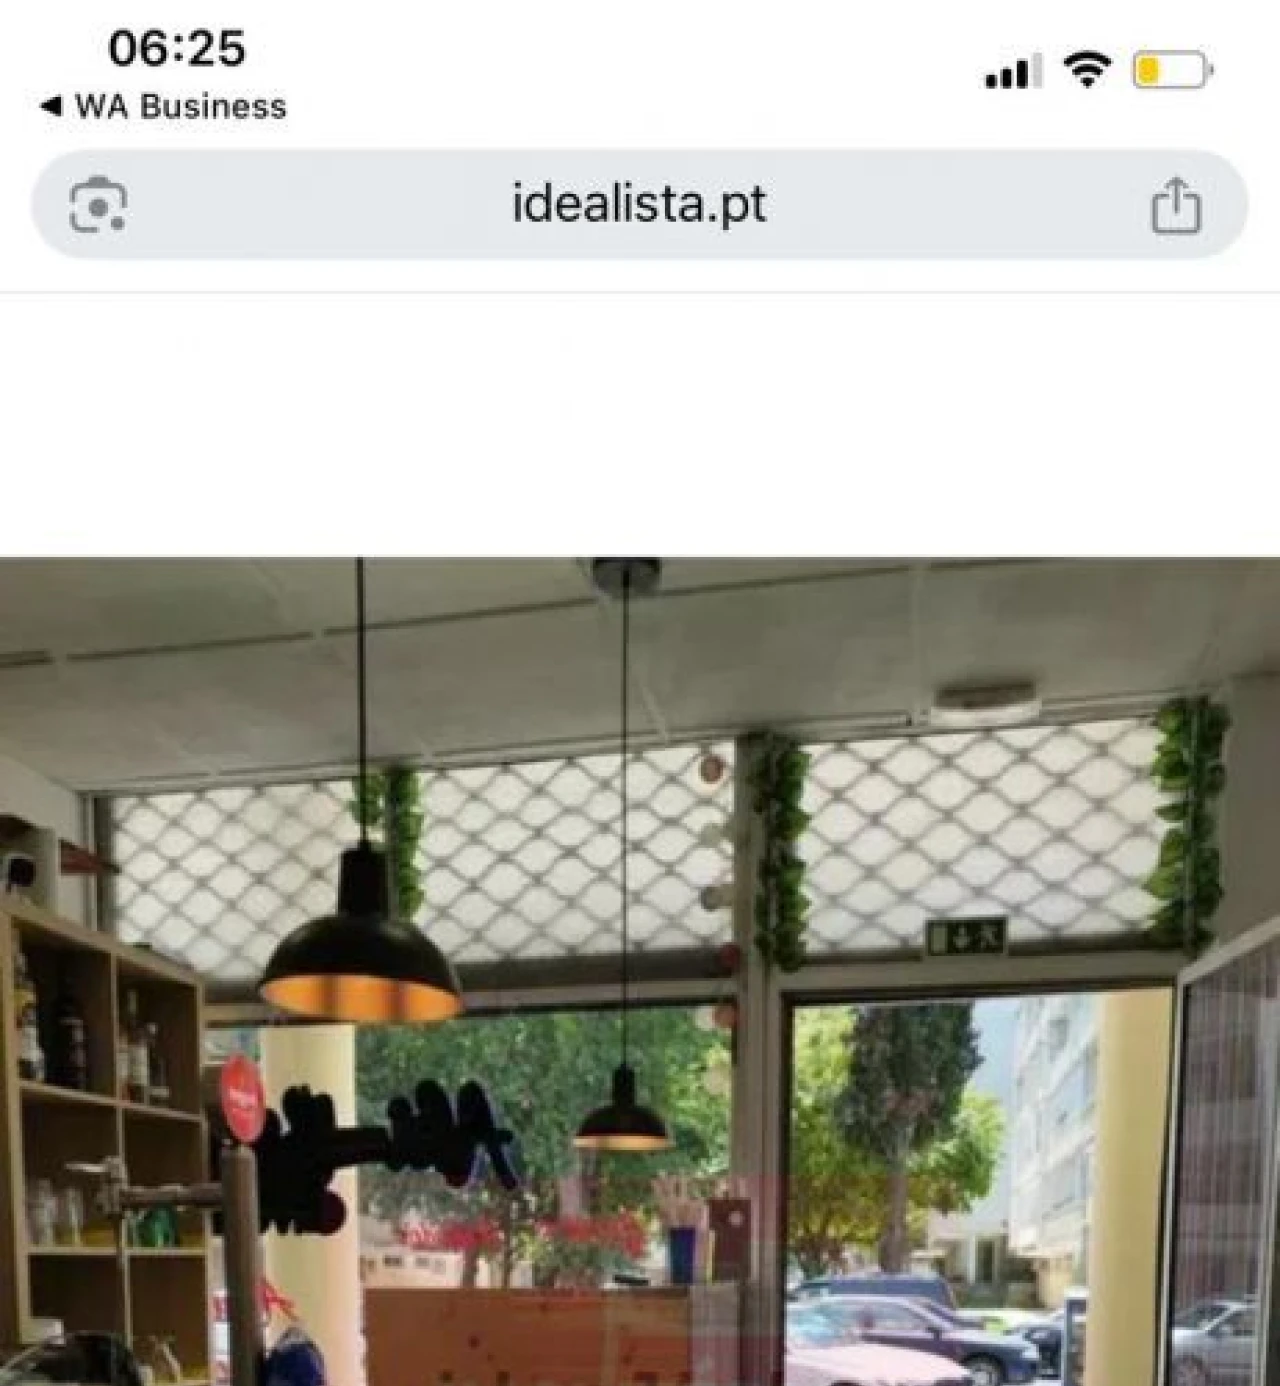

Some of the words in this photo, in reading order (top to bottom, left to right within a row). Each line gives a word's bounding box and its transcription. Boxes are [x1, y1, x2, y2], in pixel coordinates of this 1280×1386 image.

[109, 29, 245, 68] 06:25
[75, 93, 129, 120] WA
[140, 92, 287, 121] Business
[513, 181, 767, 231] idealista.pt
